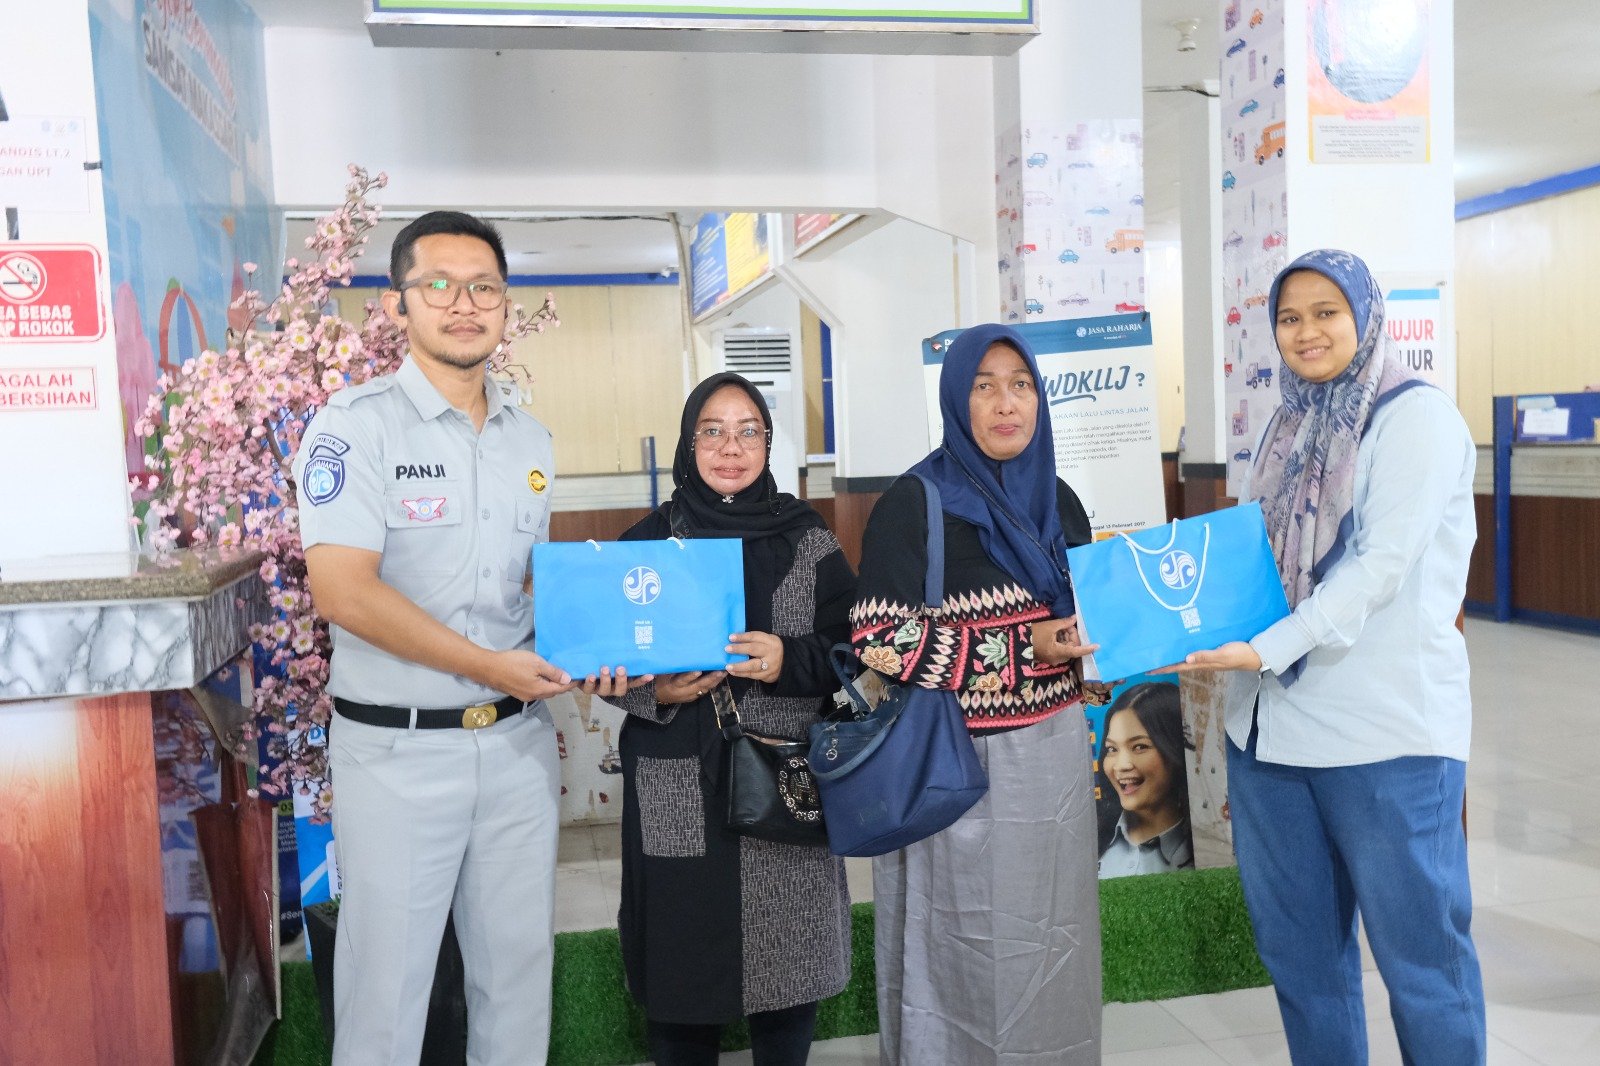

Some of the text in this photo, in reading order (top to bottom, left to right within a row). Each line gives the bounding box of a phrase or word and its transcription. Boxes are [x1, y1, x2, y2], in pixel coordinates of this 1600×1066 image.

[19, 304, 72, 320] BEBAS
[19, 320, 75, 336] ROKOK
[1088, 323, 1142, 336] JASA RAHARJA
[1080, 410, 1098, 418] LALU
[1100, 407, 1124, 416] LINTAS
[1126, 406, 1149, 414] JALAN
[395, 463, 447, 481] PANJI
